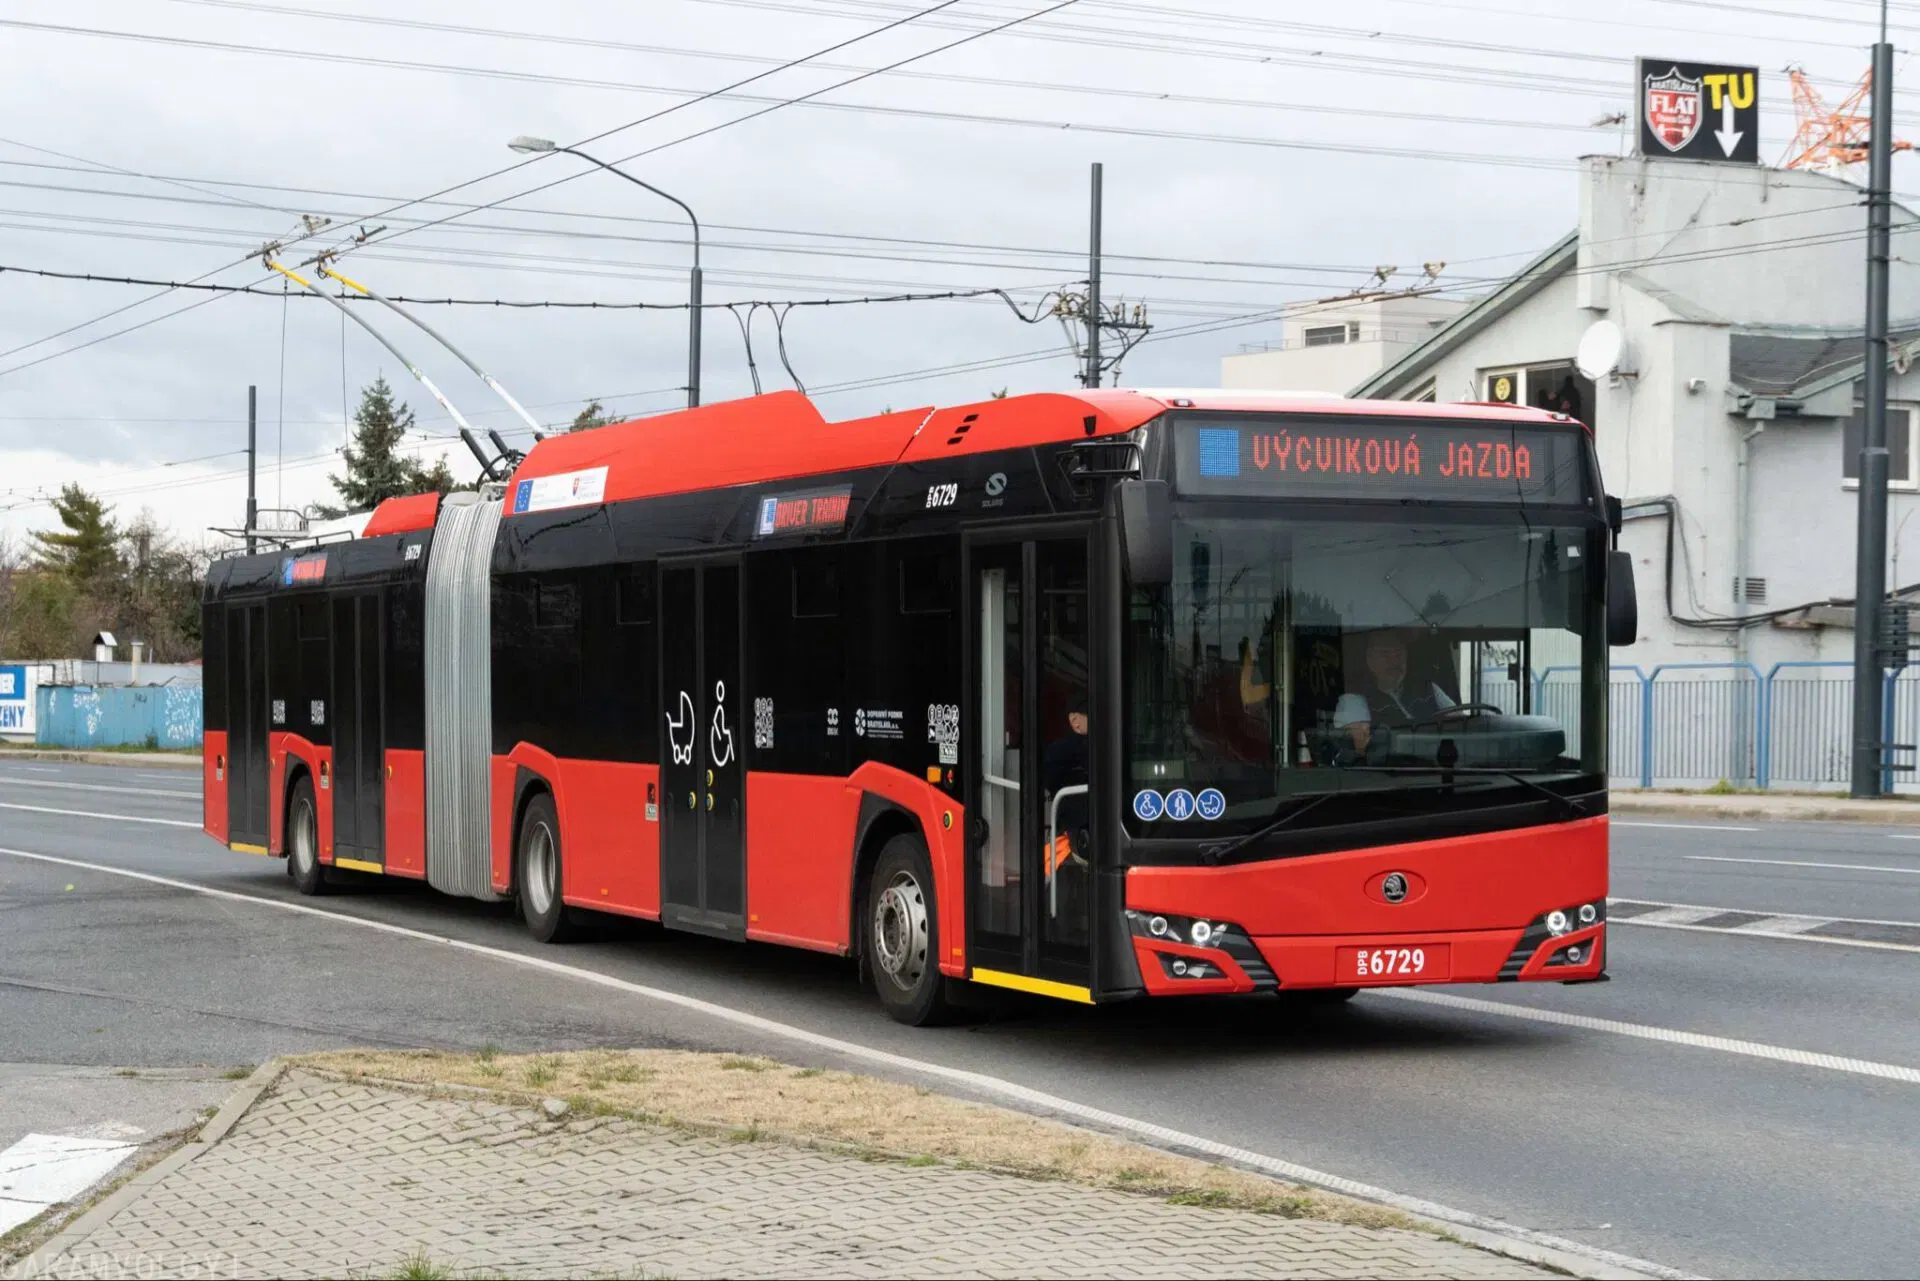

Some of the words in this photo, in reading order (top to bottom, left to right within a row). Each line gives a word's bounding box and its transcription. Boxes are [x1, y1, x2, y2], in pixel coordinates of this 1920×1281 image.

[1650, 94, 1697, 115] FLAT
[1703, 73, 1755, 110] TU
[1253, 429, 1420, 475] VÝCVIKOVÁ
[1439, 441, 1531, 479] JAZDA
[932, 482, 958, 508] 6729
[1357, 950, 1368, 975] DPB
[1370, 948, 1425, 974] 6729
